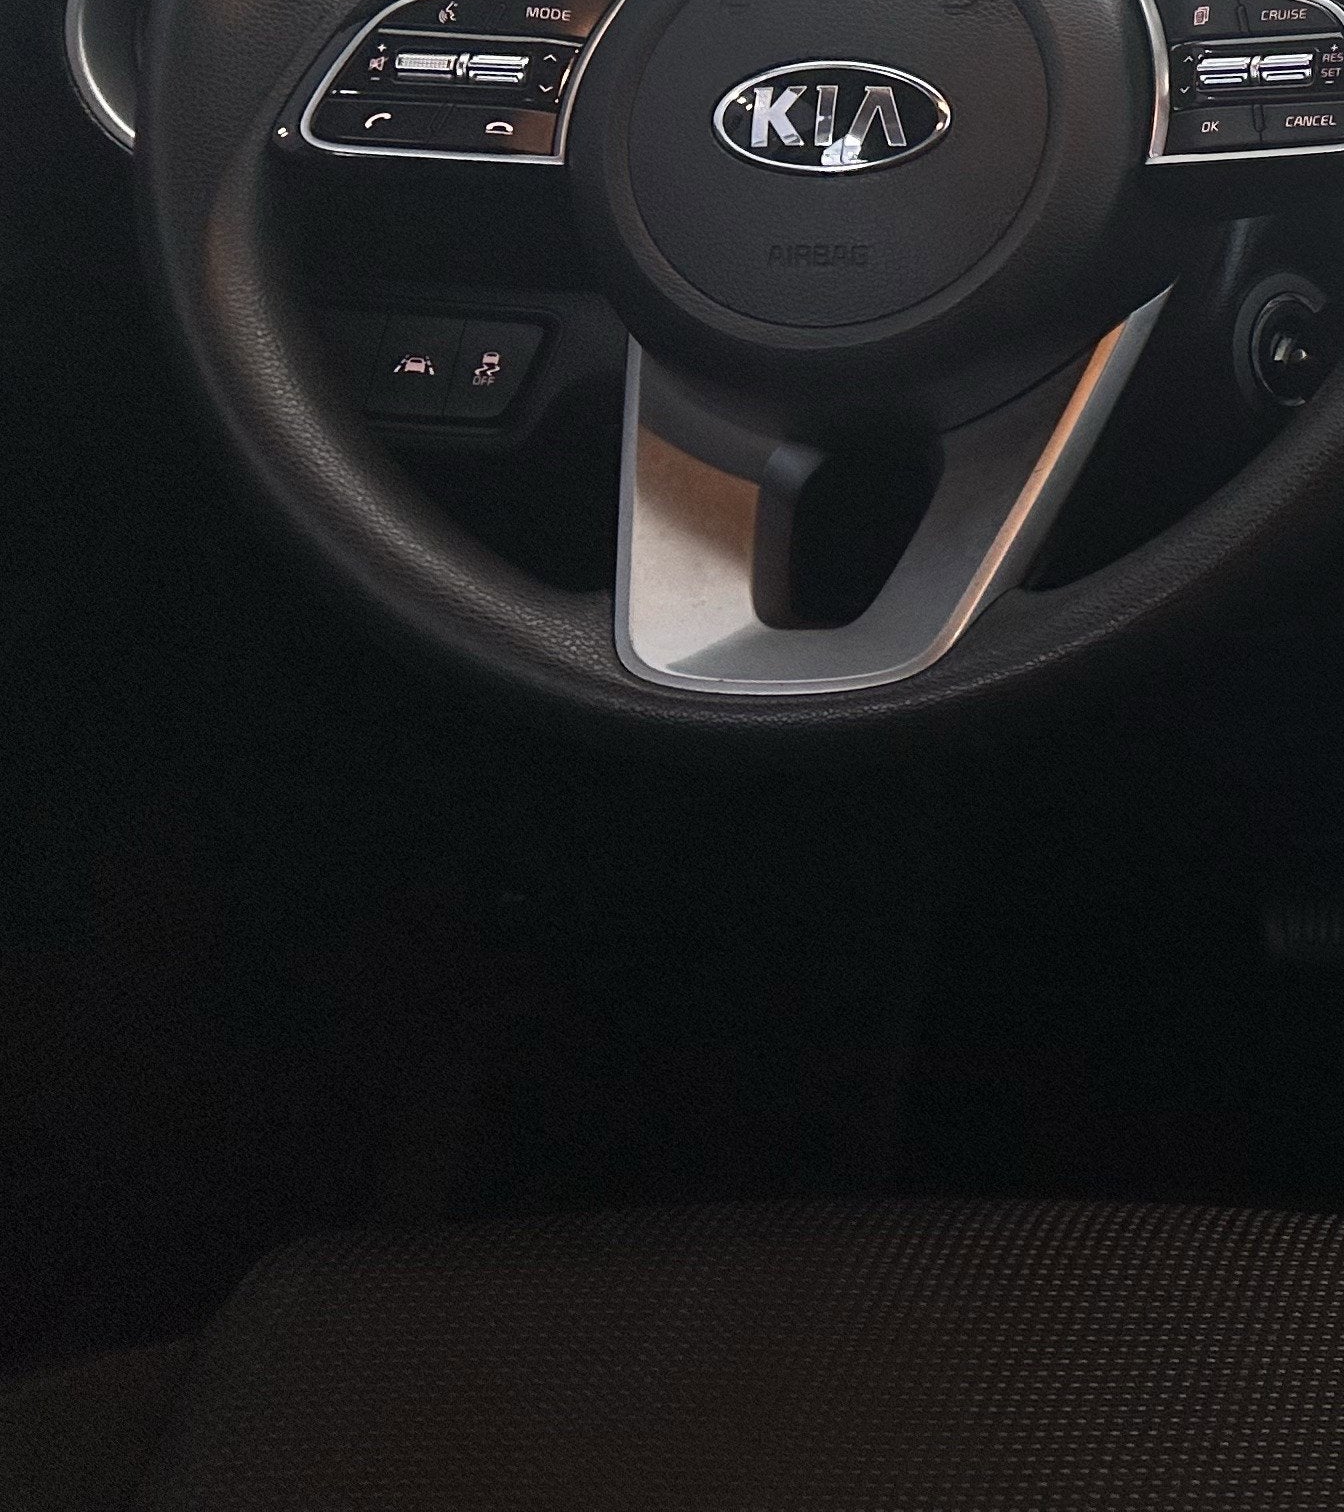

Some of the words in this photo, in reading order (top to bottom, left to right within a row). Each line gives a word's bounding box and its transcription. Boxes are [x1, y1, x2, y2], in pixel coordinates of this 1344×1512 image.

[525, 6, 572, 22] MODE
[1260, 8, 1308, 21] CRUISE
[1322, 53, 1344, 63] RES
[1320, 67, 1342, 78] SET
[750, 85, 907, 148] KIA
[1285, 114, 1337, 128] CANCEL
[1201, 120, 1220, 133] OK
[472, 375, 496, 386] OFF
